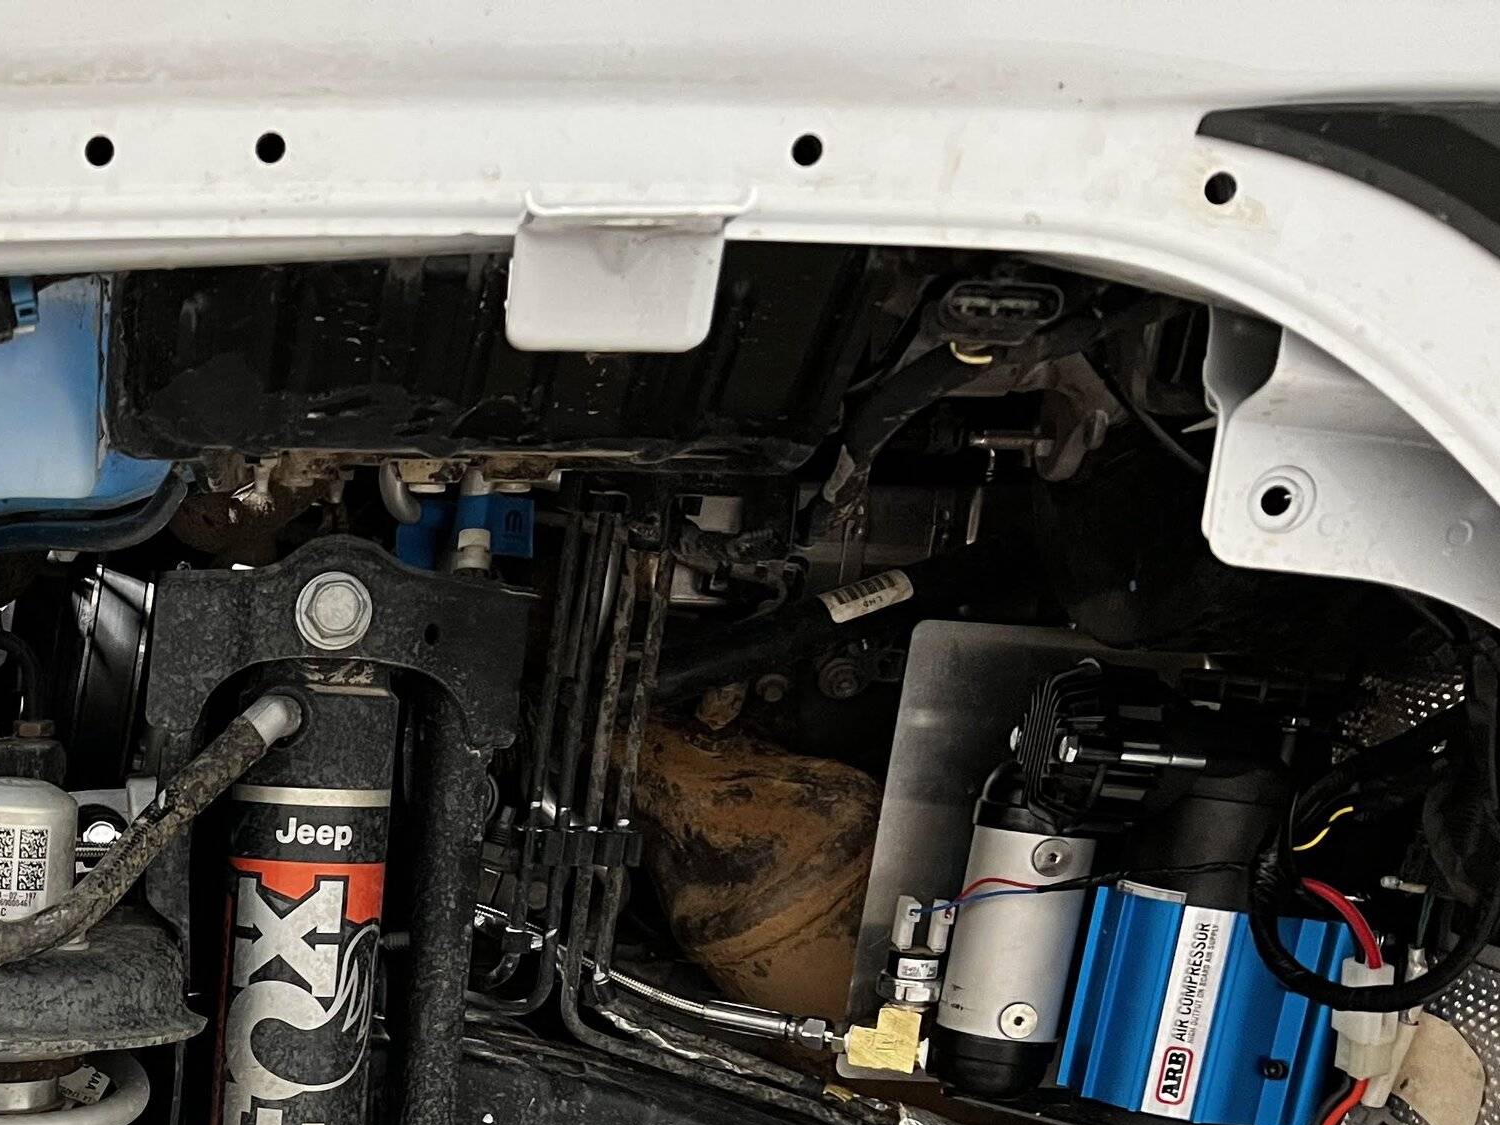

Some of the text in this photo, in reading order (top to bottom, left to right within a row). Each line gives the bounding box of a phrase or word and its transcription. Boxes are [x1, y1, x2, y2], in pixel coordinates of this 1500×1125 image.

[275, 817, 353, 851] Jeep
[1170, 922, 1211, 1042] AIR COMPRESSOR
[1161, 1051, 1187, 1099] ARB
